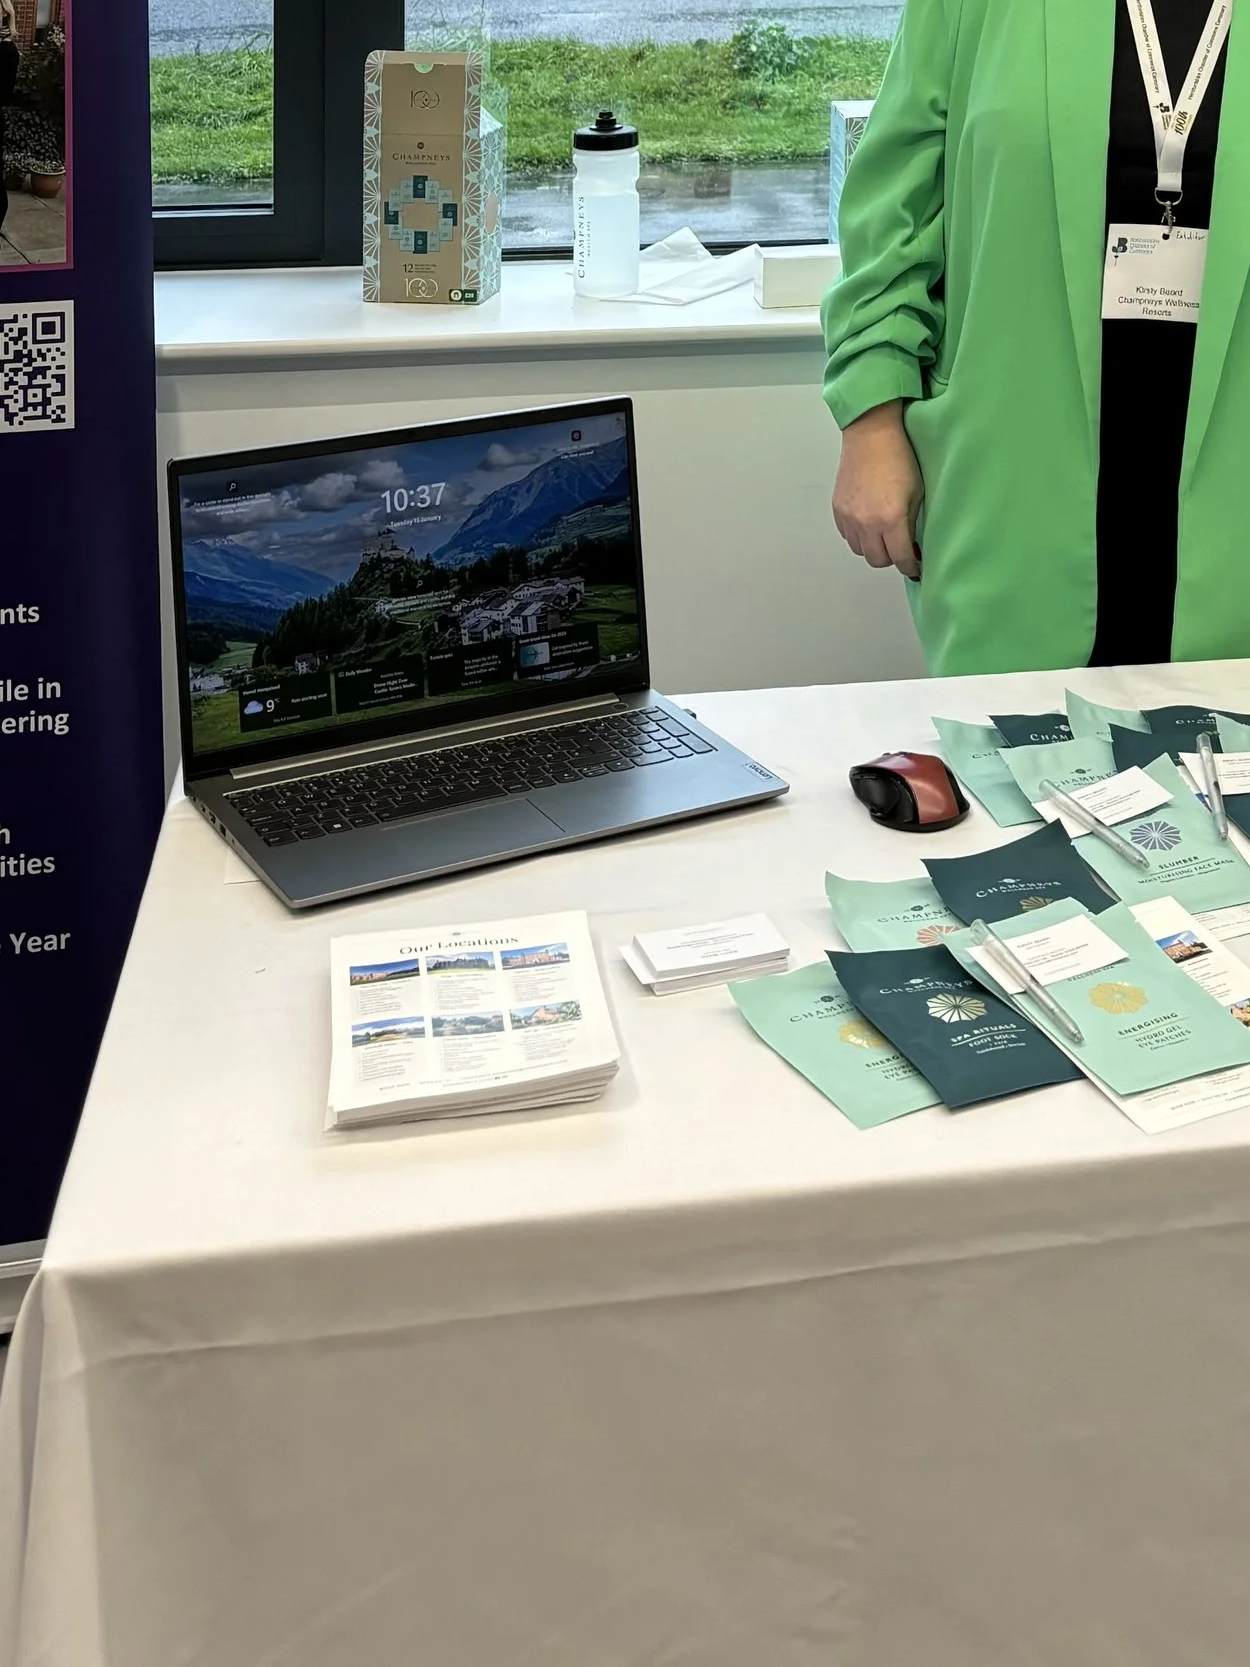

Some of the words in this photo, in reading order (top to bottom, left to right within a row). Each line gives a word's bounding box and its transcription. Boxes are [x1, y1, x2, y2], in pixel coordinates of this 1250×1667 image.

[403, 263, 414, 274] 12
[380, 481, 447, 514] 10:37
[37, 677, 61, 700] in
[9, 931, 71, 955] Year
[438, 936, 519, 950] Locations
[973, 1022, 1018, 1035] RITUALS
[1118, 1011, 1179, 1037] ENERGISING
